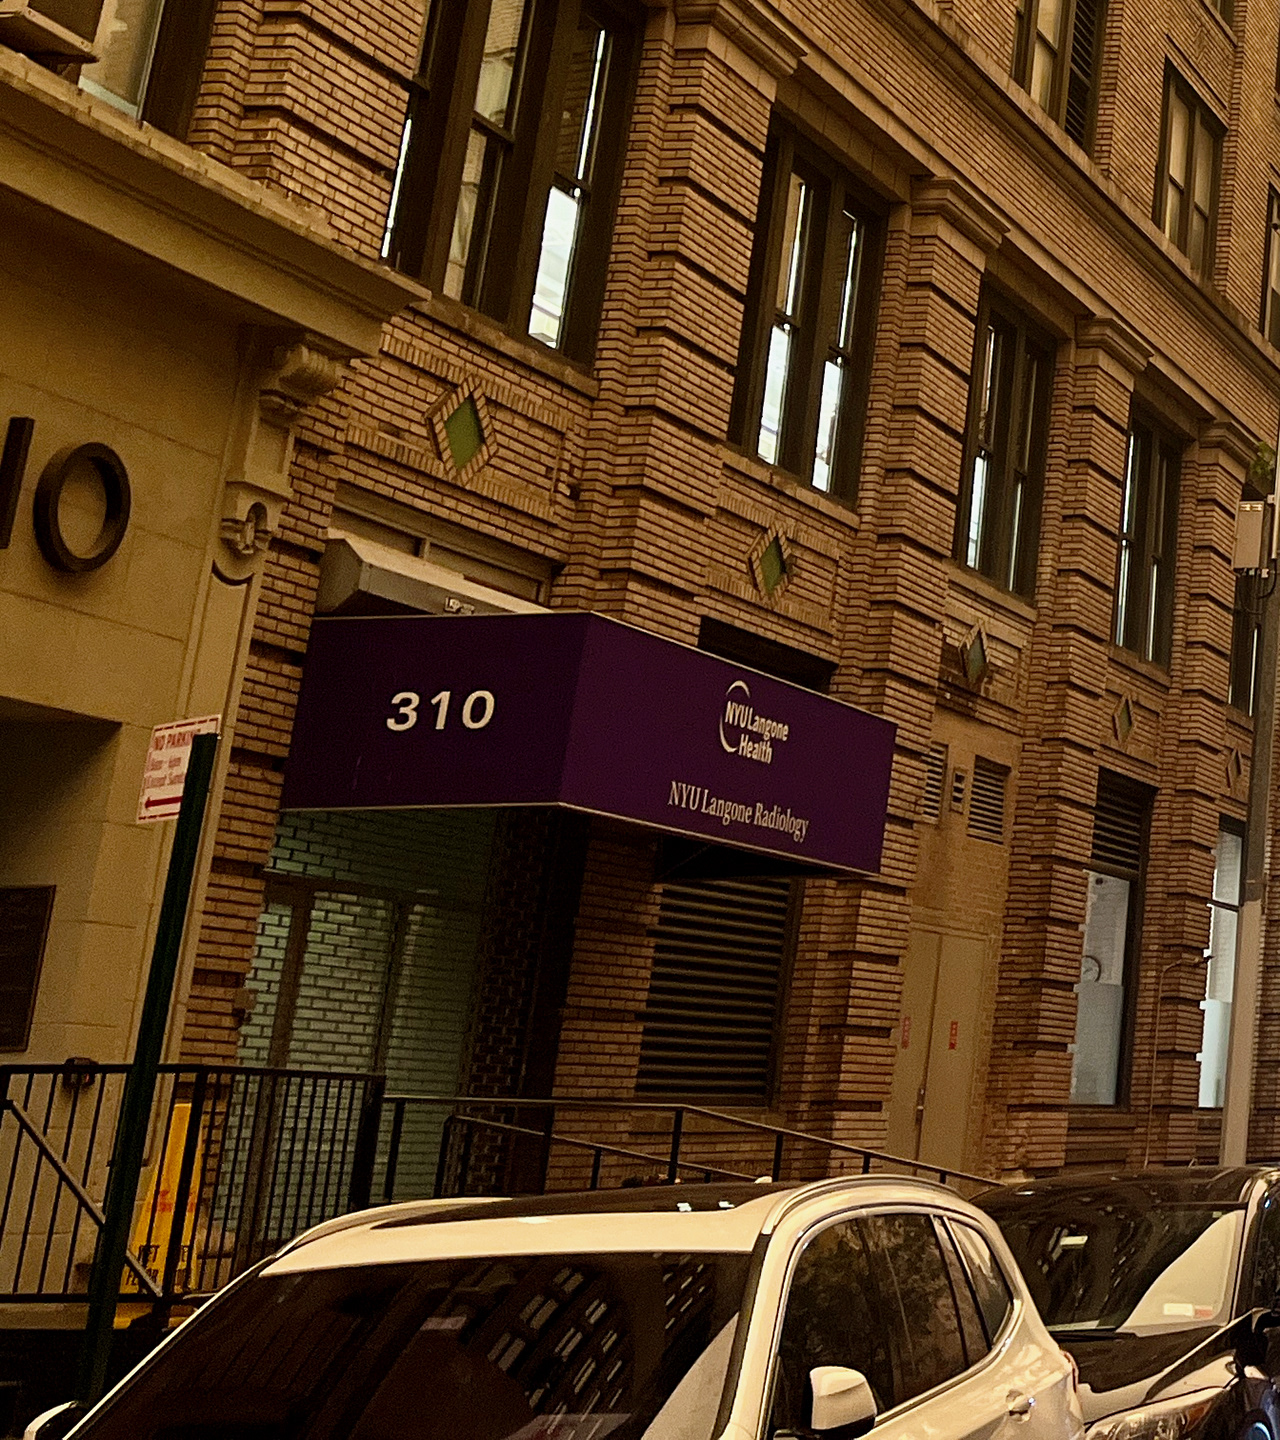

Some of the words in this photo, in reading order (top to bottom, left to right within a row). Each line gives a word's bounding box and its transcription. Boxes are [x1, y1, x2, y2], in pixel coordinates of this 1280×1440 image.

[386, 690, 495, 732] 310
[738, 733, 773, 764] Health
[667, 780, 701, 811] NYU
[700, 789, 753, 826] Langone
[753, 802, 809, 843] Radiology
